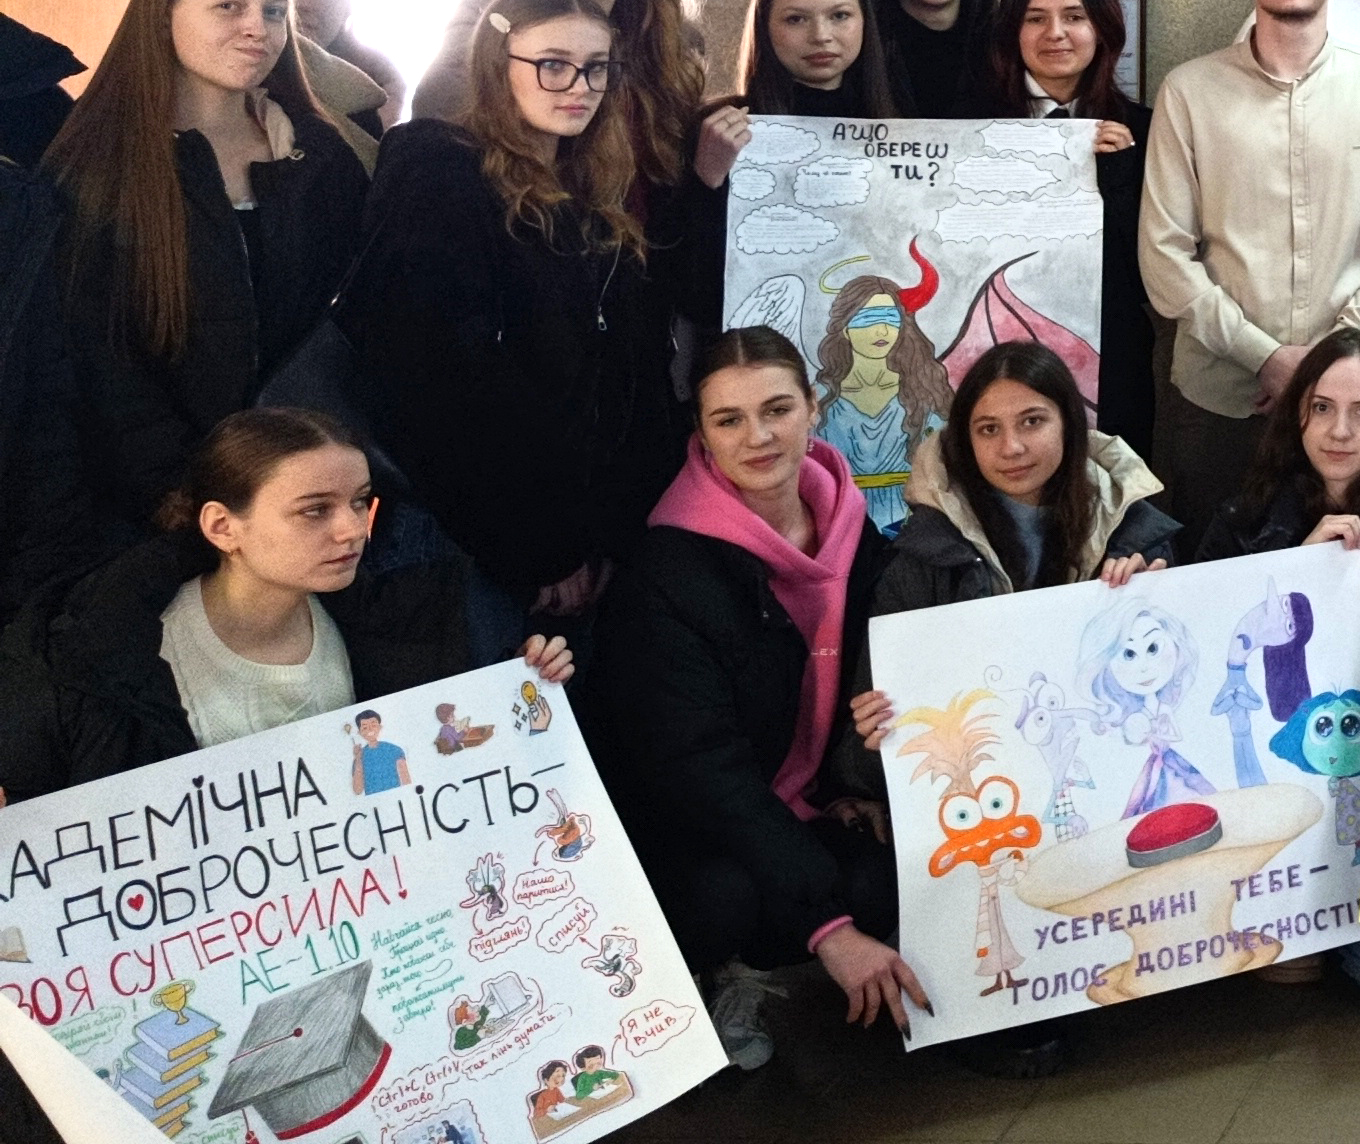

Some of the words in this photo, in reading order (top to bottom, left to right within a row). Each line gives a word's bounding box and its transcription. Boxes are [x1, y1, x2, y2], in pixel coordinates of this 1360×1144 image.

[864, 141, 949, 159] ОБЕРЕШ
[890, 161, 941, 188] ТИ?
[57, 766, 539, 956] ДОБРОЧЕСНІСТЬ
[1033, 890, 1198, 951] УСЕРЕДИНІ
[1230, 863, 1303, 904] ТЕБЕ
[109, 854, 409, 996] СУПЕРСИЛА!
[473, 922, 529, 955] підглянь!
[548, 903, 591, 948] списуй
[1011, 963, 1109, 1006] ГОЛОС
[626, 1016, 639, 1032] Я
[644, 1006, 663, 1023] не
[425, 1060, 460, 1085] Ctrl+V
[394, 1092, 434, 1112] готово
